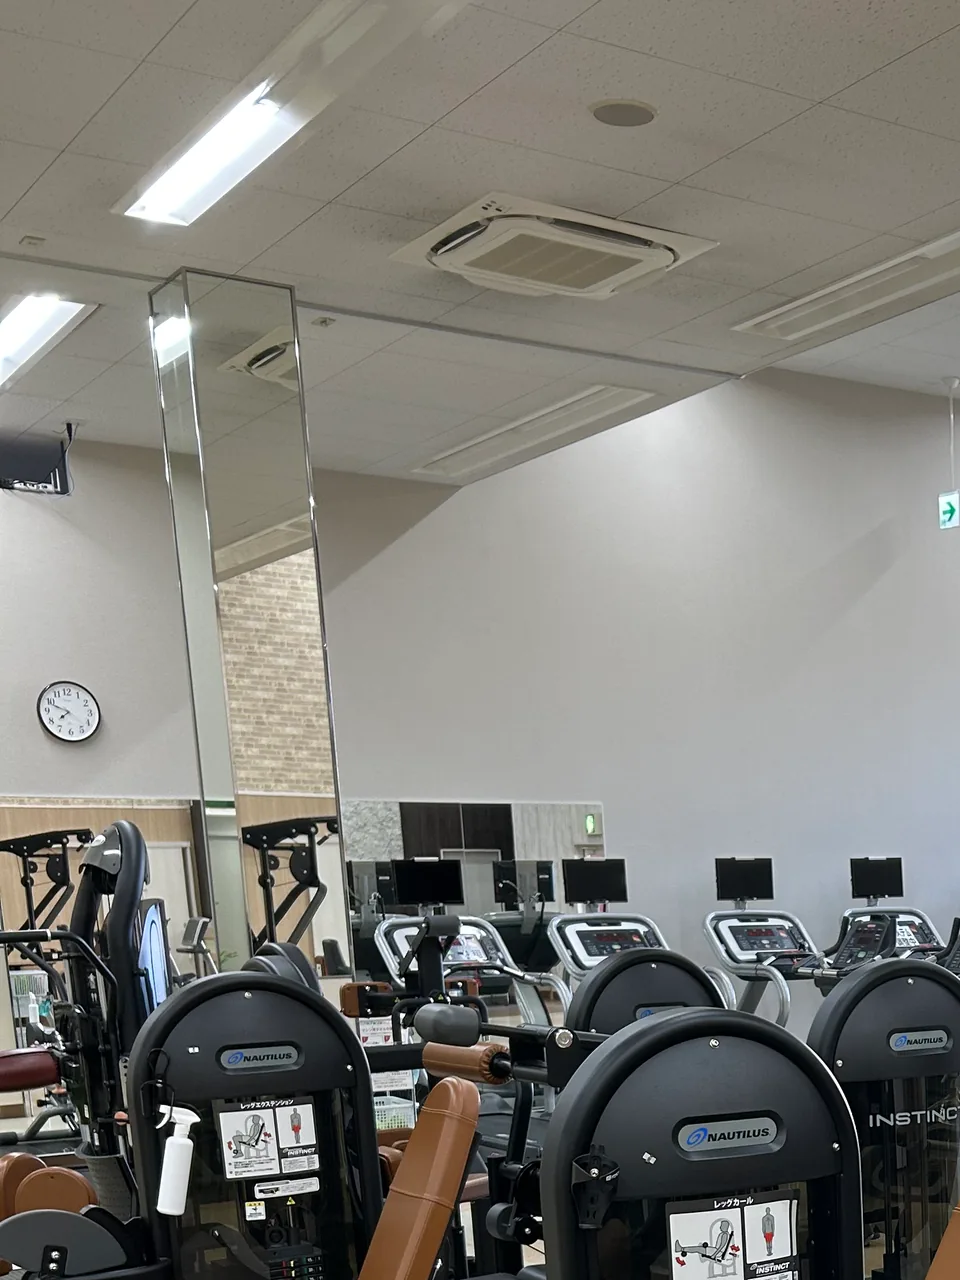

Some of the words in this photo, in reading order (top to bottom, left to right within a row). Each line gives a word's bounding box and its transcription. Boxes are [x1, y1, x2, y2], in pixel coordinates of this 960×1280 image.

[62, 688, 72, 696] 12
[48, 717, 54, 725] 8
[68, 728, 74, 736] 6
[80, 726, 84, 734] 5
[906, 1036, 944, 1046] NAUTILUS
[243, 1052, 293, 1062] NAUTILUS
[707, 1128, 770, 1142] NAUTILUS
[714, 1196, 754, 1208] レッグカール
[756, 1262, 790, 1275] INSTINCT
